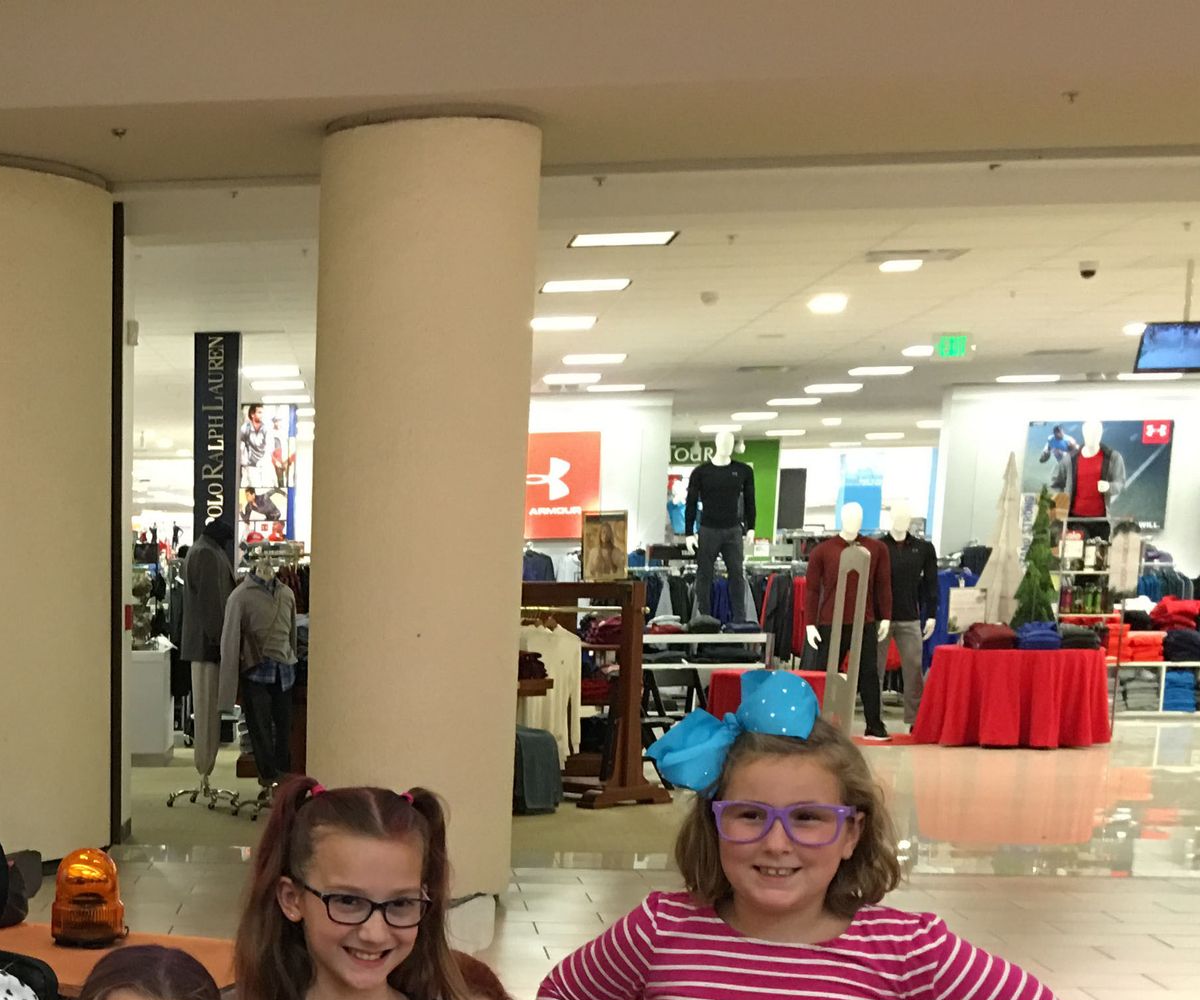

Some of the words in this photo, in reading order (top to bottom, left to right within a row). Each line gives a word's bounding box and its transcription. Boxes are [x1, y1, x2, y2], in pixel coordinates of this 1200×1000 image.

[202, 336, 225, 412] LAUREN
[202, 415, 225, 480] RALPH
[528, 506, 582, 516] ARMOUR
